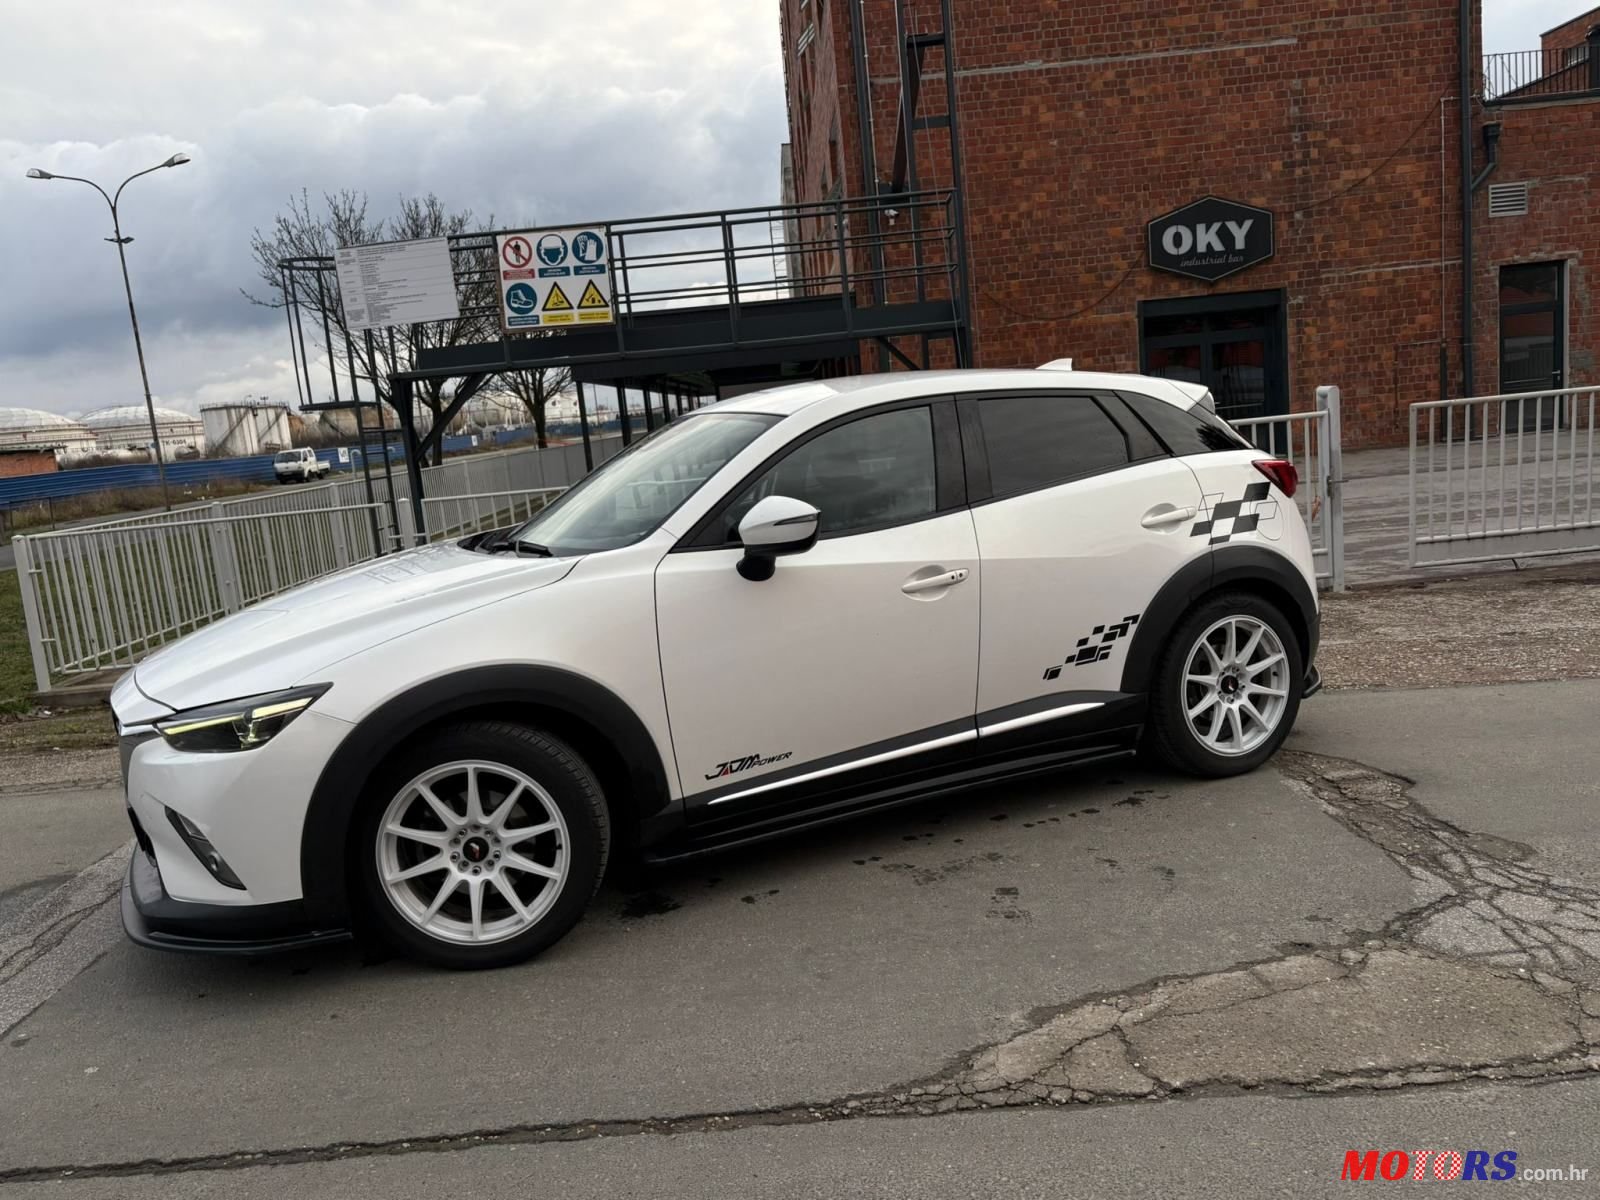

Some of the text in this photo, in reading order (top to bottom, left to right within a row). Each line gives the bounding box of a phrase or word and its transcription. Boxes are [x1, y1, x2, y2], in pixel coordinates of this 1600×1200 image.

[1162, 219, 1254, 255] OKY
[1180, 253, 1244, 267] industrial bar
[751, 751, 792, 769] POWER
